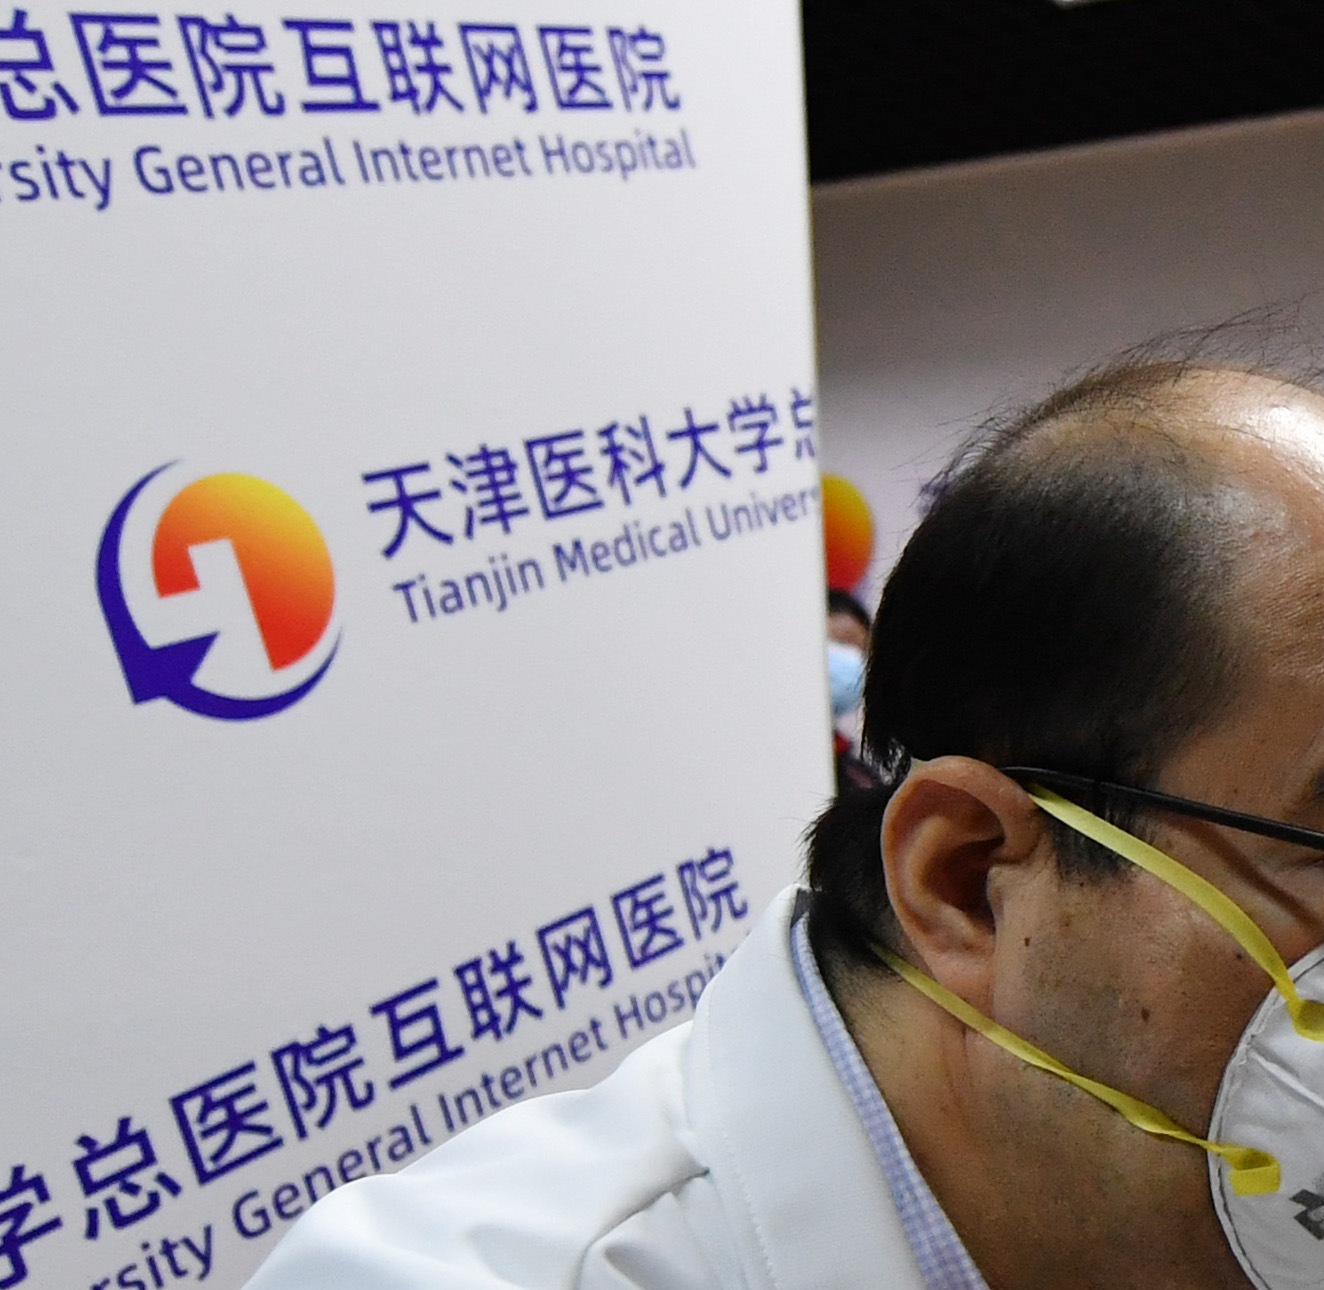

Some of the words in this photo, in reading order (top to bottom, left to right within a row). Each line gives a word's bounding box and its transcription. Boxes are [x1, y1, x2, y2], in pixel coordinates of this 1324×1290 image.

[0, 9, 681, 120] 总医院互联网医院
[0, 144, 110, 211] sity
[134, 137, 346, 194] General
[352, 136, 533, 184] Internet
[538, 127, 697, 181] Hospital
[392, 553, 545, 624] Tianjin
[553, 506, 702, 582] Medical
[231, 1103, 432, 1239] General
[437, 1017, 609, 1133] Internet
